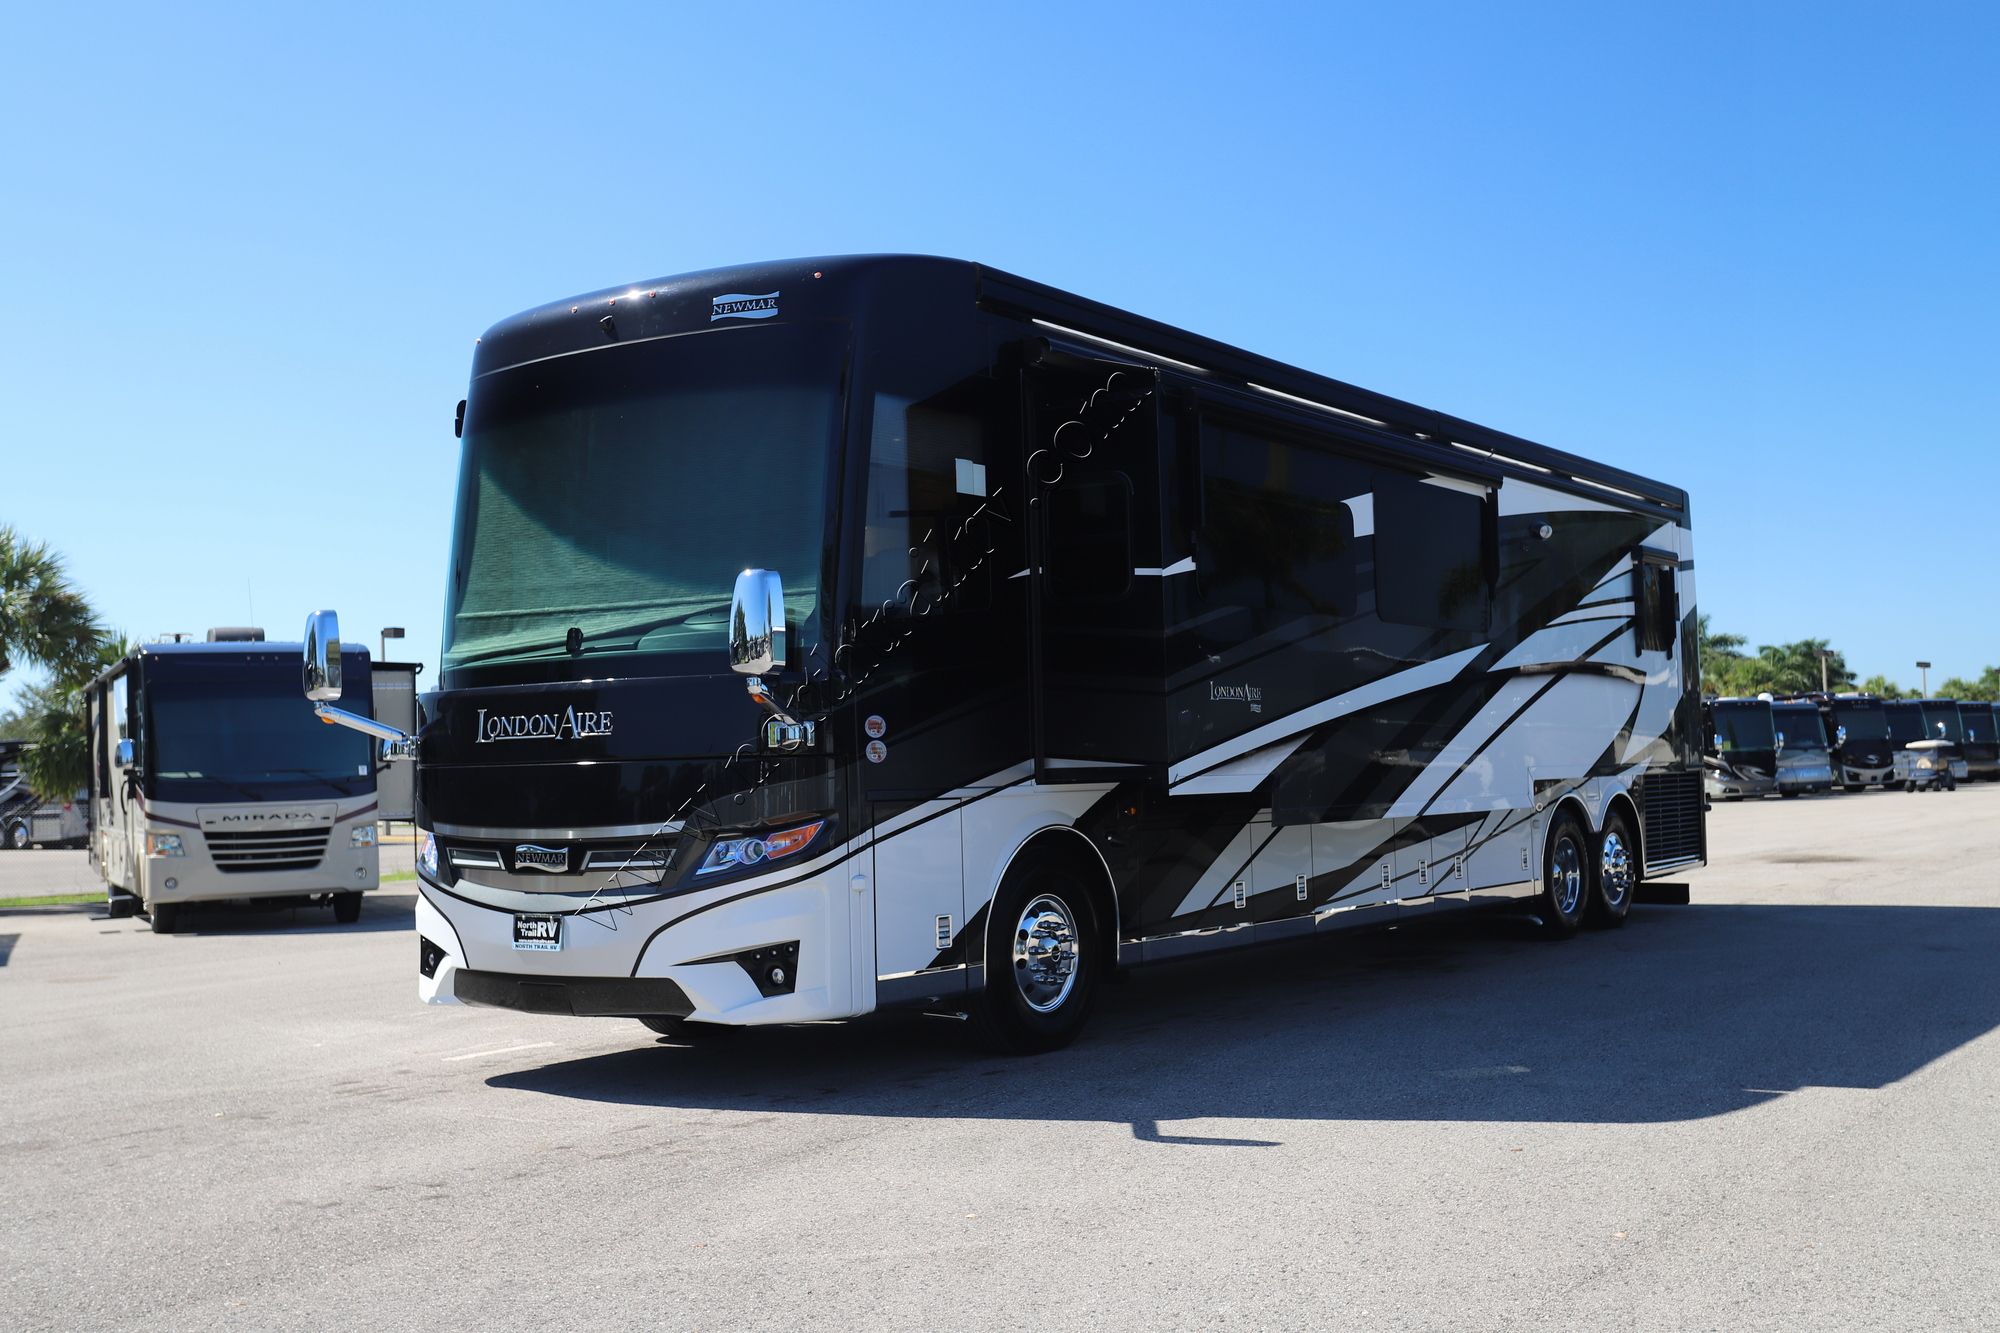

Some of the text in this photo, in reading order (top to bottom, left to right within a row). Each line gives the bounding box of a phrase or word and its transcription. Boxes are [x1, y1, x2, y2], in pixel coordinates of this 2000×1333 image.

[712, 299, 778, 315] NEWMAR
[222, 812, 315, 822] MIRADA
[517, 853, 565, 864] NEWMAR
[517, 921, 537, 929] North
[537, 921, 558, 938] RV
[520, 929, 537, 937] Trail
